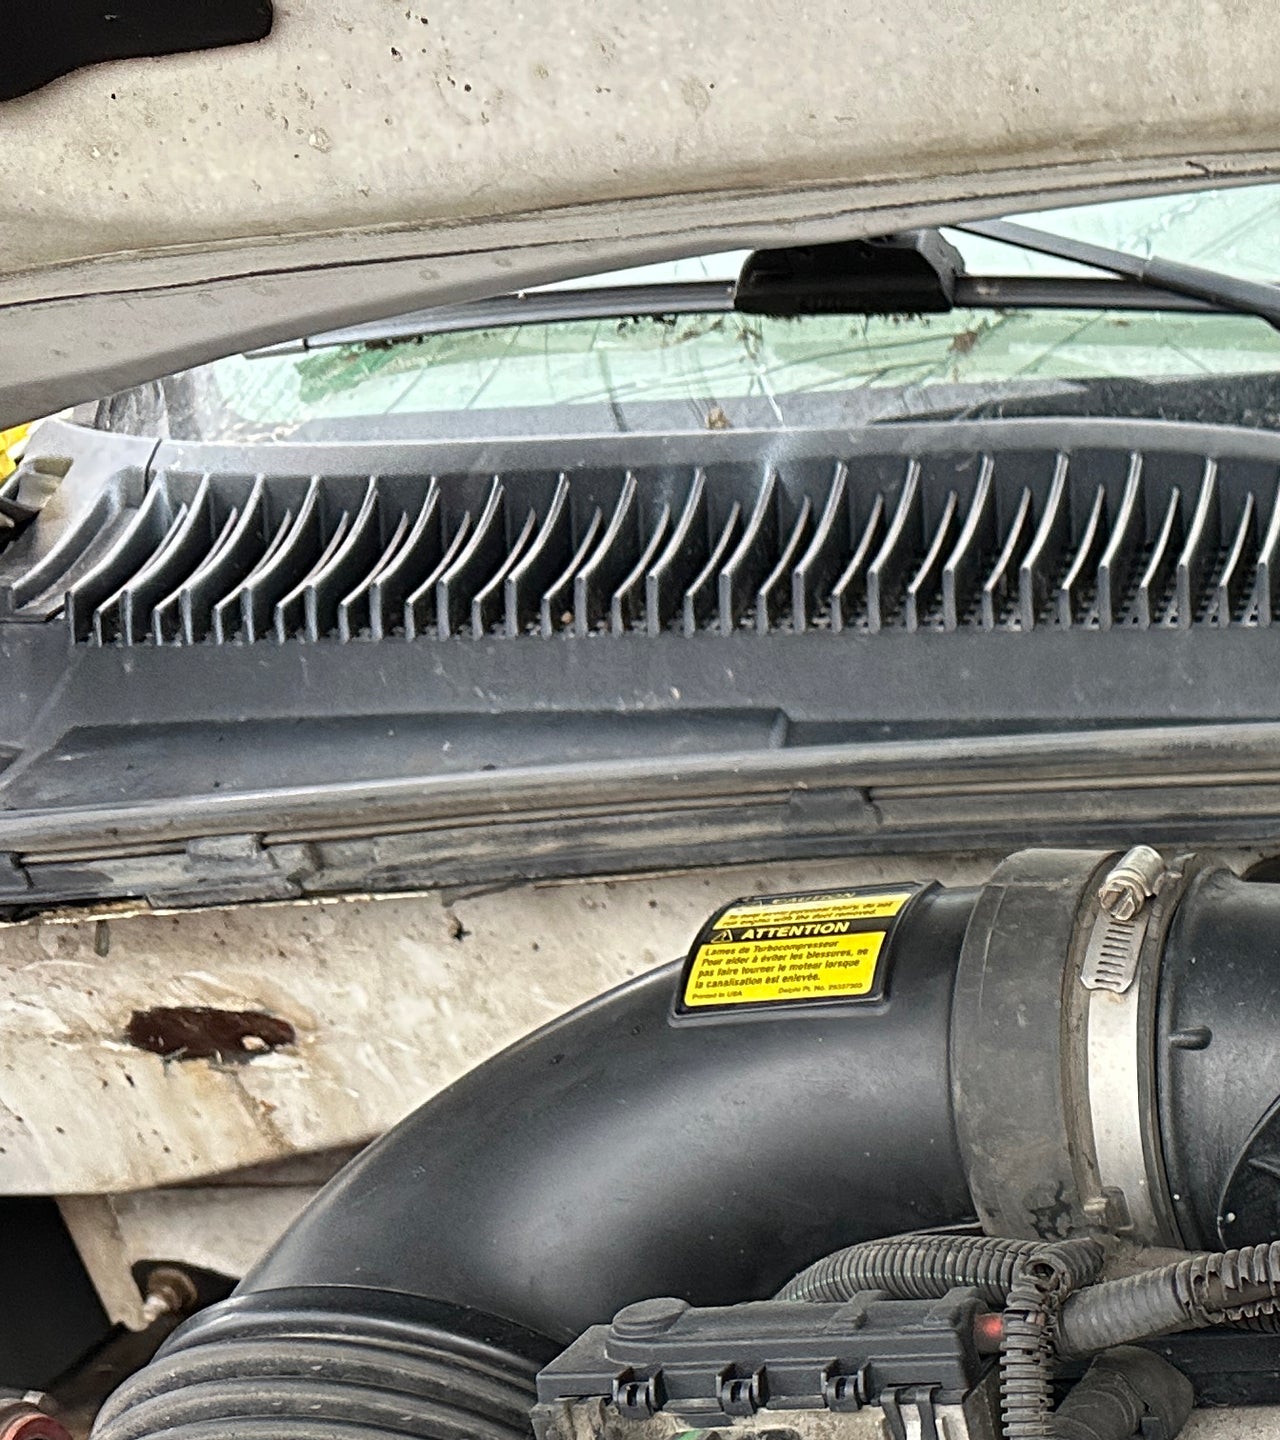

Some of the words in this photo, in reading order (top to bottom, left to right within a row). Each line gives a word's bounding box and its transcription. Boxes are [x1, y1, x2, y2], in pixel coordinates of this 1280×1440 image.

[741, 921, 850, 942] ATTENTION
[701, 957, 723, 967] Pour
[725, 956, 750, 966] aider
[752, 954, 758, 964] à
[760, 953, 787, 963] éviter
[789, 951, 804, 961] les
[806, 948, 855, 960] blessures,
[739, 946, 751, 955] de
[697, 969, 715, 980] pas
[717, 966, 739, 977] faire
[741, 964, 775, 975] tourner
[777, 963, 787, 973] le
[789, 960, 823, 971] moteur
[825, 959, 860, 970] lorsque
[695, 980, 704, 989] la
[706, 976, 763, 988] canalisation
[781, 973, 820, 983] enlevée.
